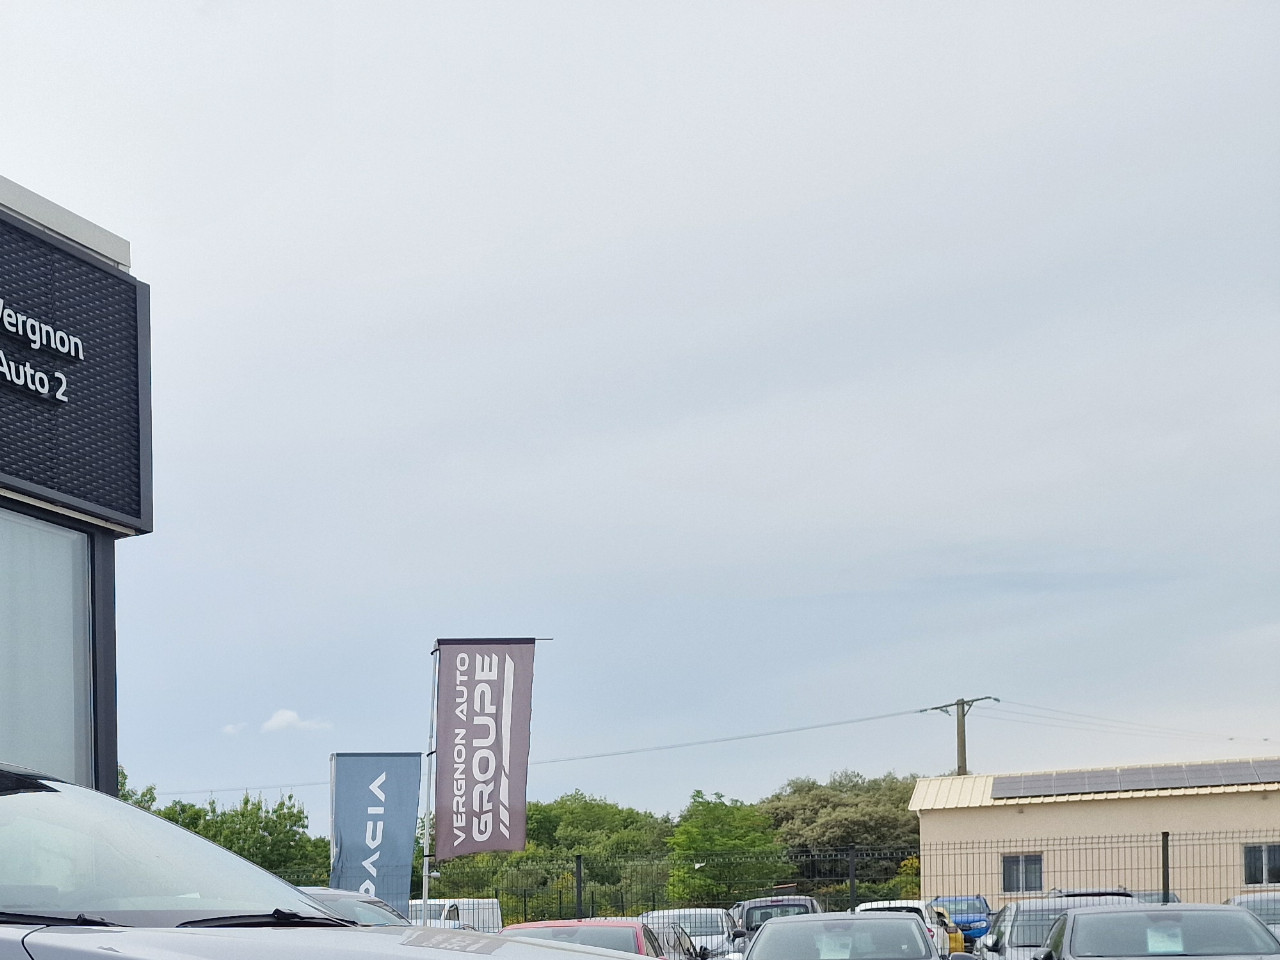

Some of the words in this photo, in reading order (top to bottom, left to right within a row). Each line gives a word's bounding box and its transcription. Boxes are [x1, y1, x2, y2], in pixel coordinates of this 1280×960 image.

[54, 371, 69, 403] 2
[455, 652, 470, 722] AUTO
[453, 728, 467, 847] VERGNON
[472, 653, 499, 842] GROUPE
